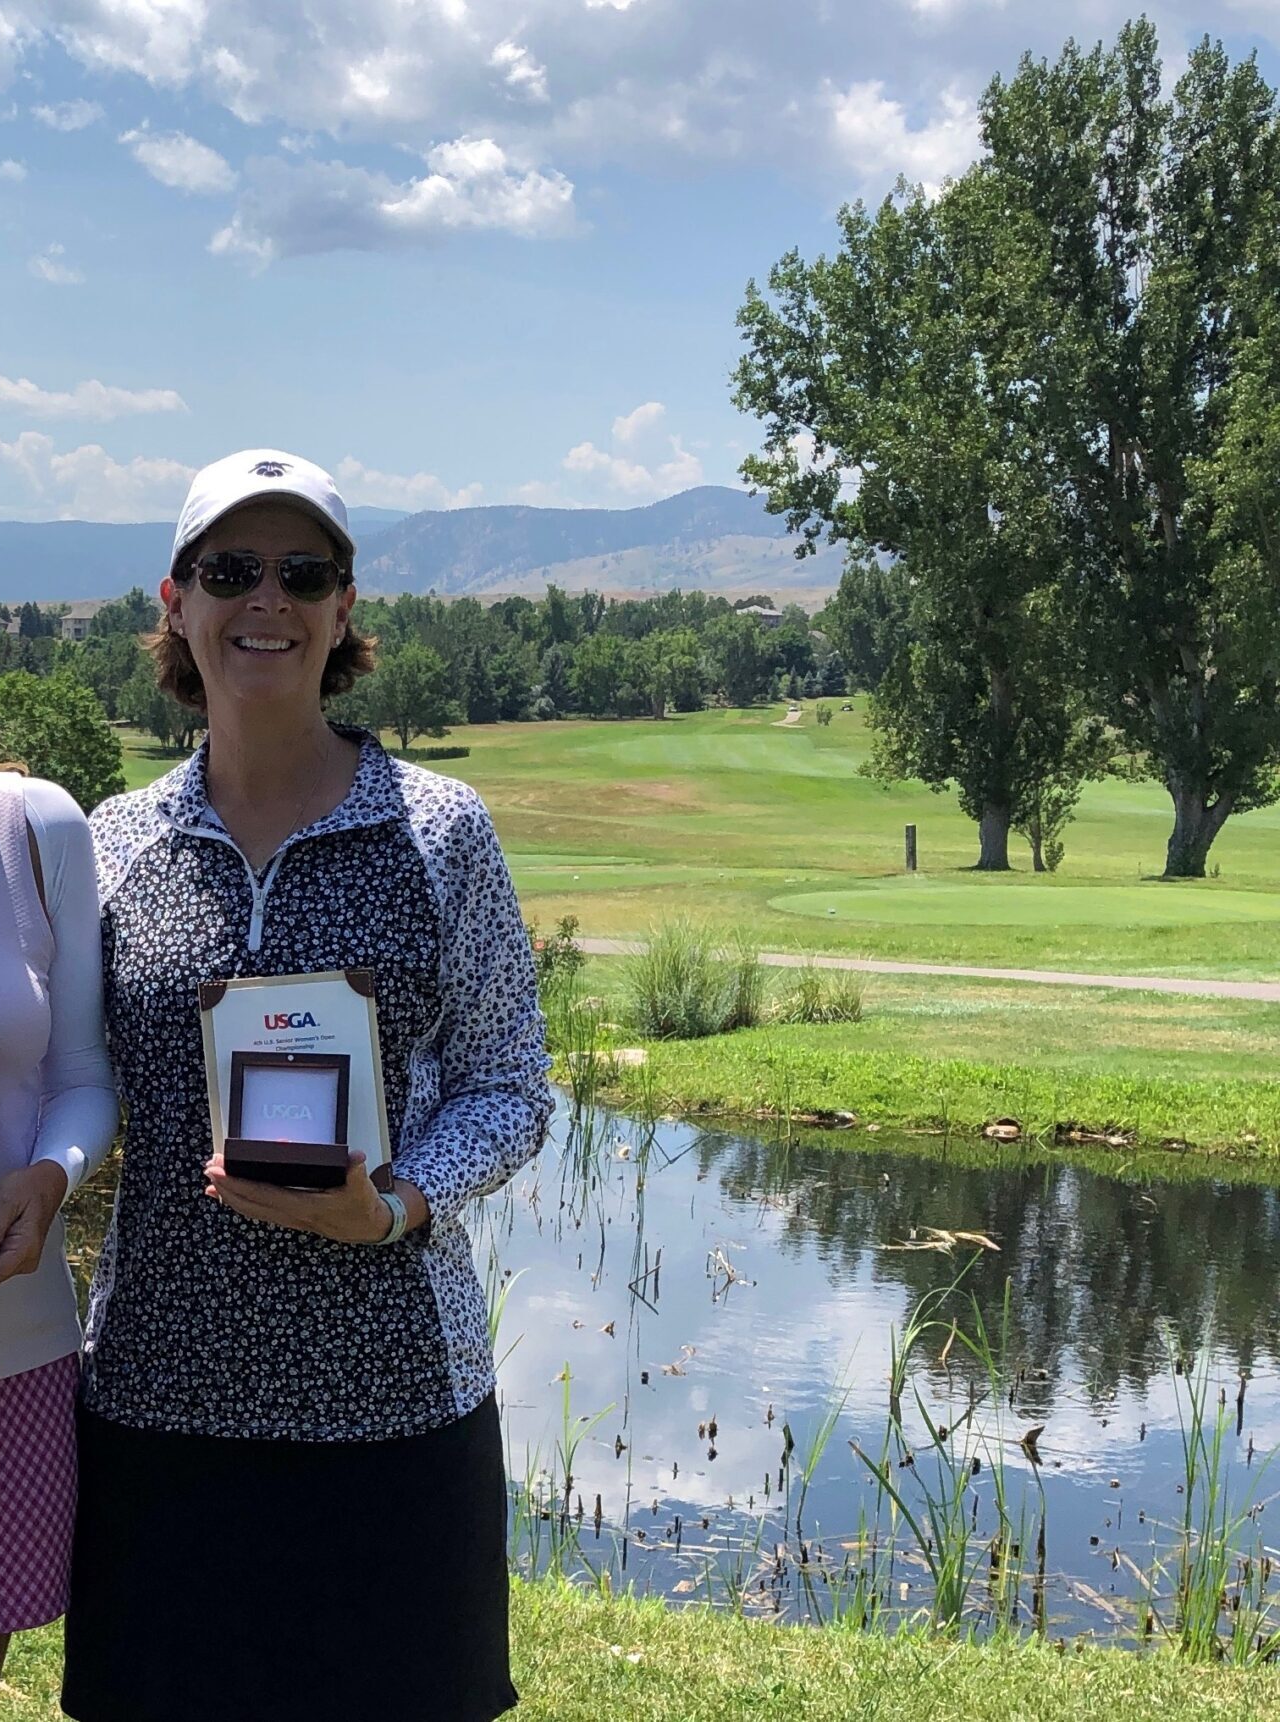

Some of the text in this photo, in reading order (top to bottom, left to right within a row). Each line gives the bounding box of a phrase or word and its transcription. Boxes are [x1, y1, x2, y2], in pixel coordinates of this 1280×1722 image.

[264, 1012, 317, 1030] USGA
[294, 1035, 319, 1043] Women's
[263, 1103, 312, 1120] USGA
